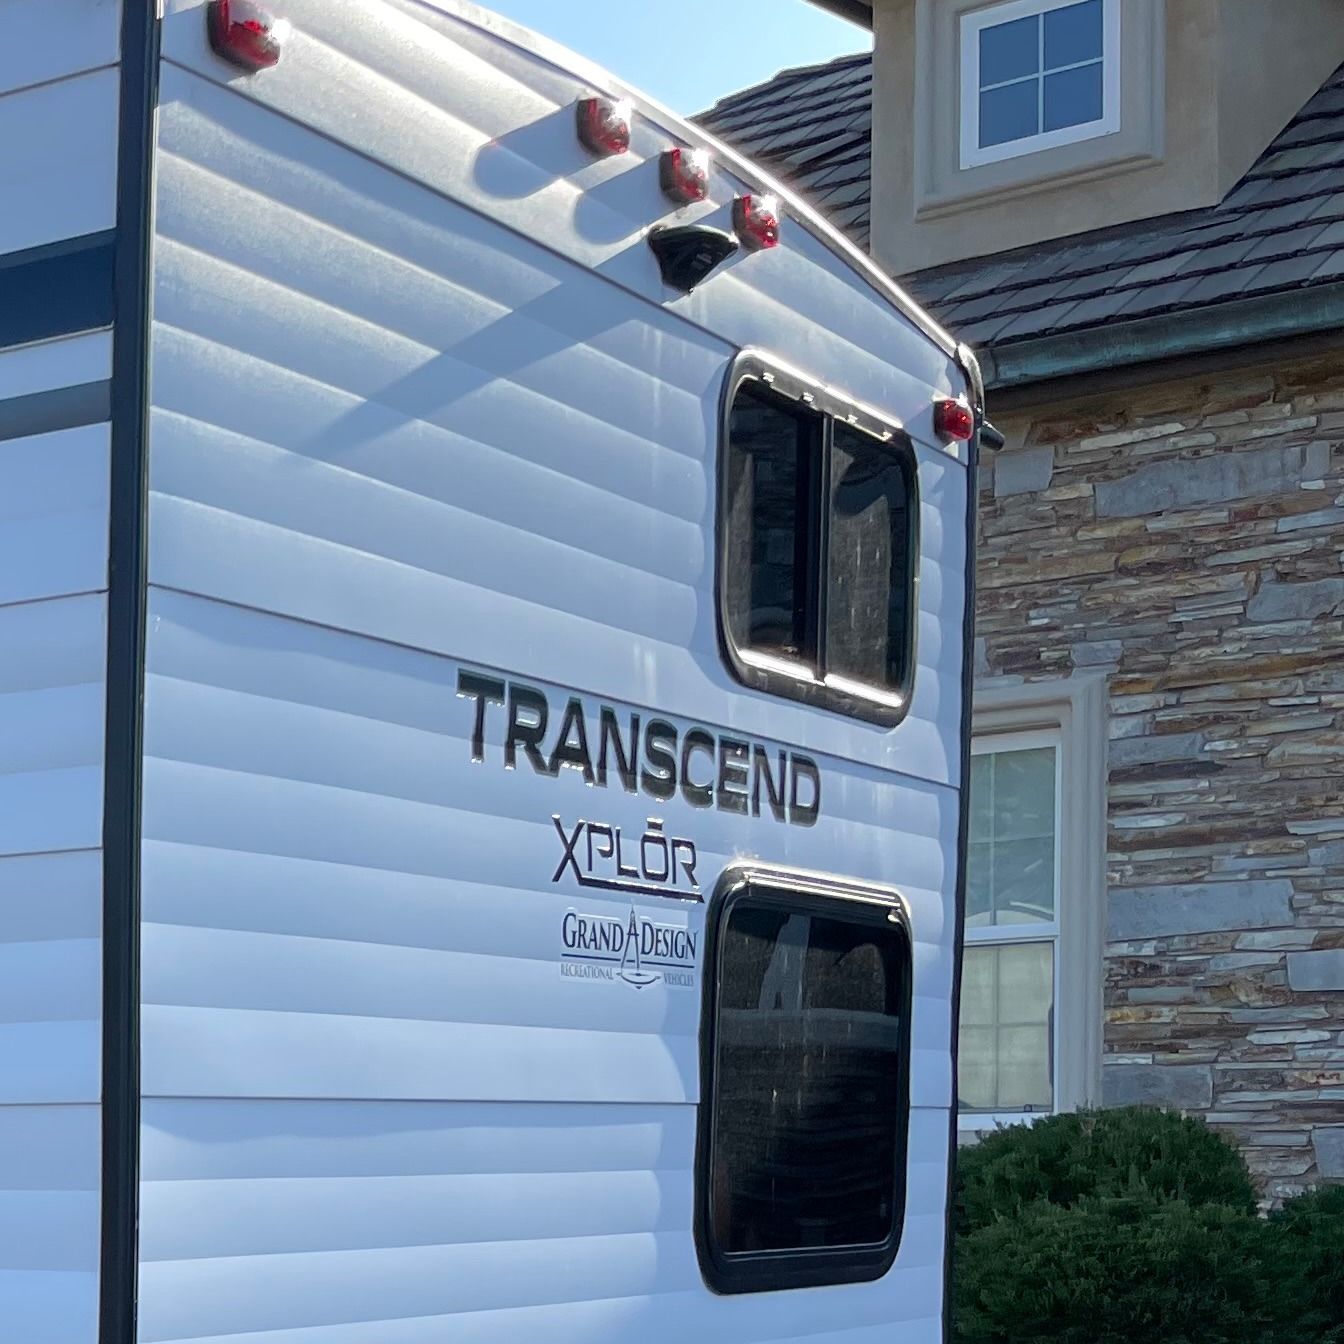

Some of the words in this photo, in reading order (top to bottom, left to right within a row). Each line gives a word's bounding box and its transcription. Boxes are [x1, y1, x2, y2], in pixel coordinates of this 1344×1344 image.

[456, 667, 821, 828] TRANSCEND
[562, 912, 624, 953] GRAND
[640, 921, 700, 960] DESIGN
[560, 963, 614, 980] RECREATIONAL
[663, 972, 694, 987] VEHICLES
